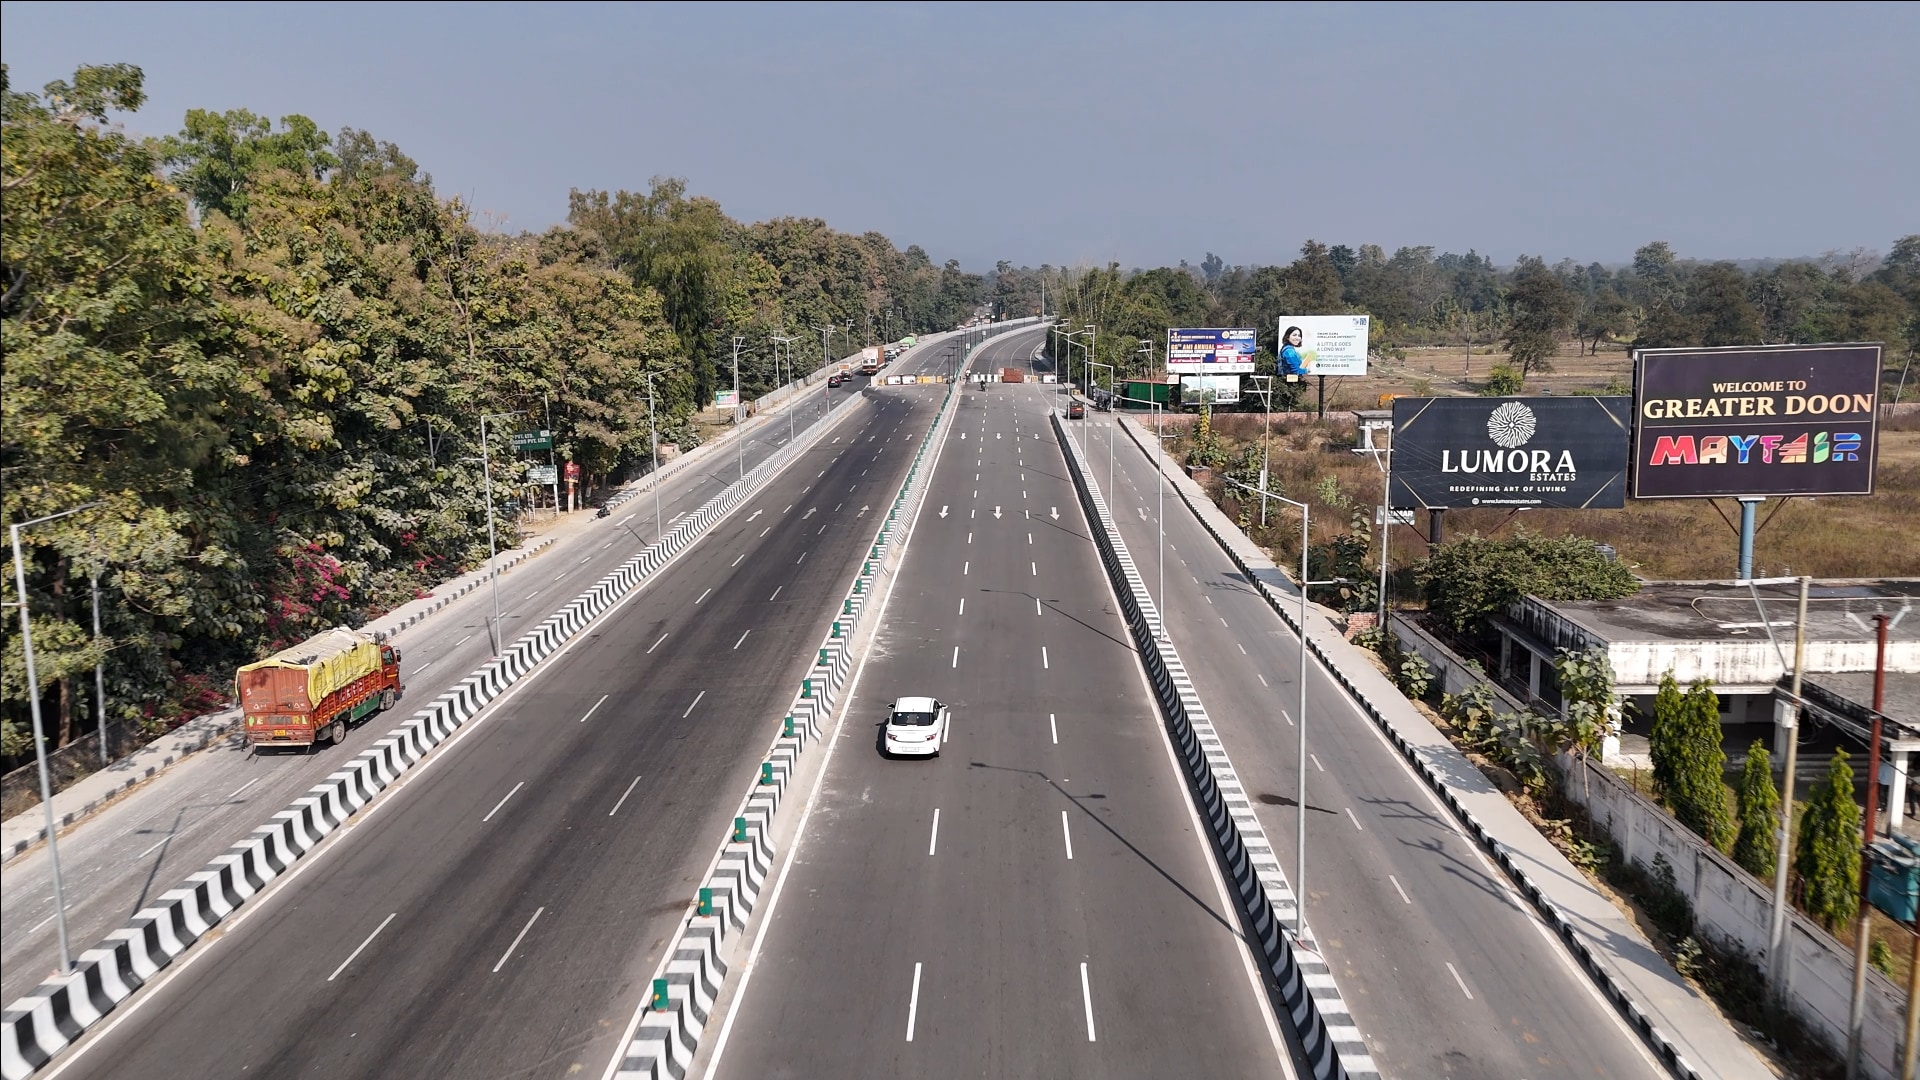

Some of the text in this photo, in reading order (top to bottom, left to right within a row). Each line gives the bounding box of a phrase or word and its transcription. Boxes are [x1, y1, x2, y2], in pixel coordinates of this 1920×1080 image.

[1712, 380, 1807, 393] WELCOME TO
[1643, 393, 1874, 419] GREATER DOON
[1649, 431, 1862, 466] MAYFAIR
[1441, 449, 1577, 473] LUMORA
[1529, 473, 1577, 482] ESTATES
